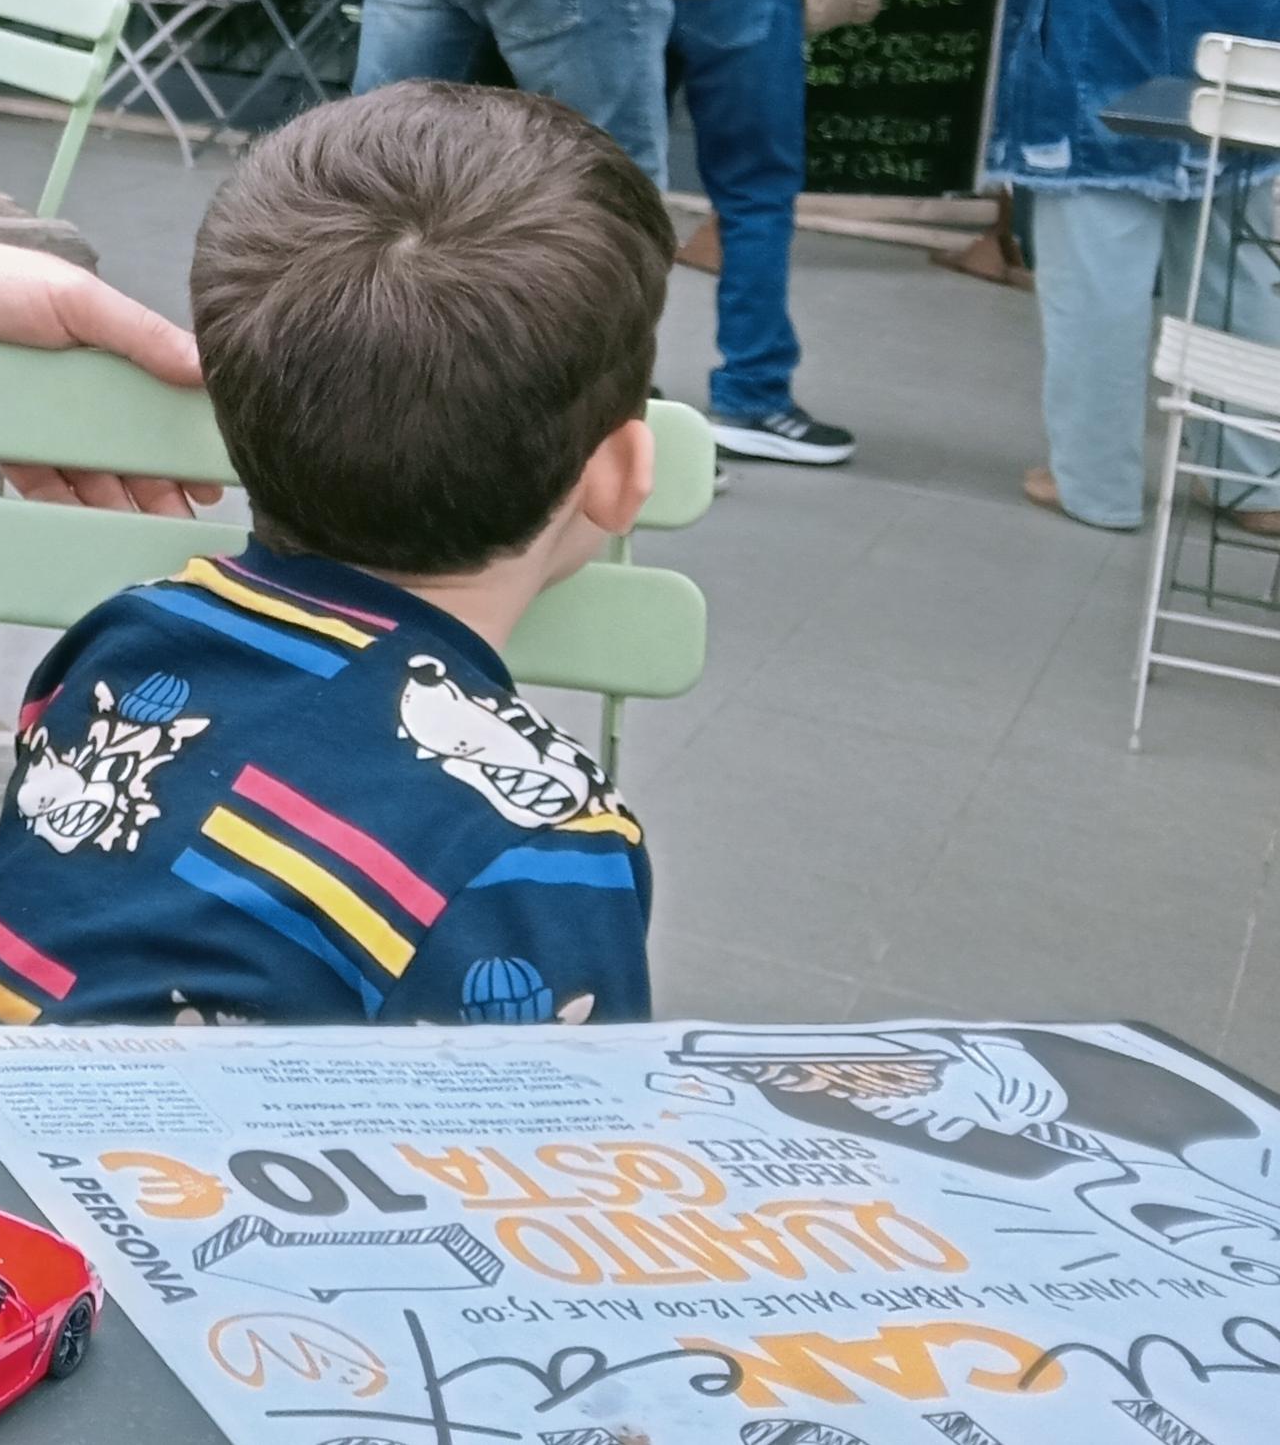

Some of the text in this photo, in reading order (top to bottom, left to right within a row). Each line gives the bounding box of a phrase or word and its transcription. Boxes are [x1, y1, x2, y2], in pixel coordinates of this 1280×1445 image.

[687, 1136, 878, 1165] SEMPLICI
[723, 1158, 870, 1188] REGOLE
[59, 1174, 198, 1307] PERSONA
[493, 1200, 970, 1287] QUANTO
[460, 1295, 554, 1326] 15:00
[553, 1295, 640, 1322] ALLE
[653, 1296, 742, 1320] 12:00
[743, 1289, 853, 1319] DALLE
[984, 1284, 1029, 1308] AL
